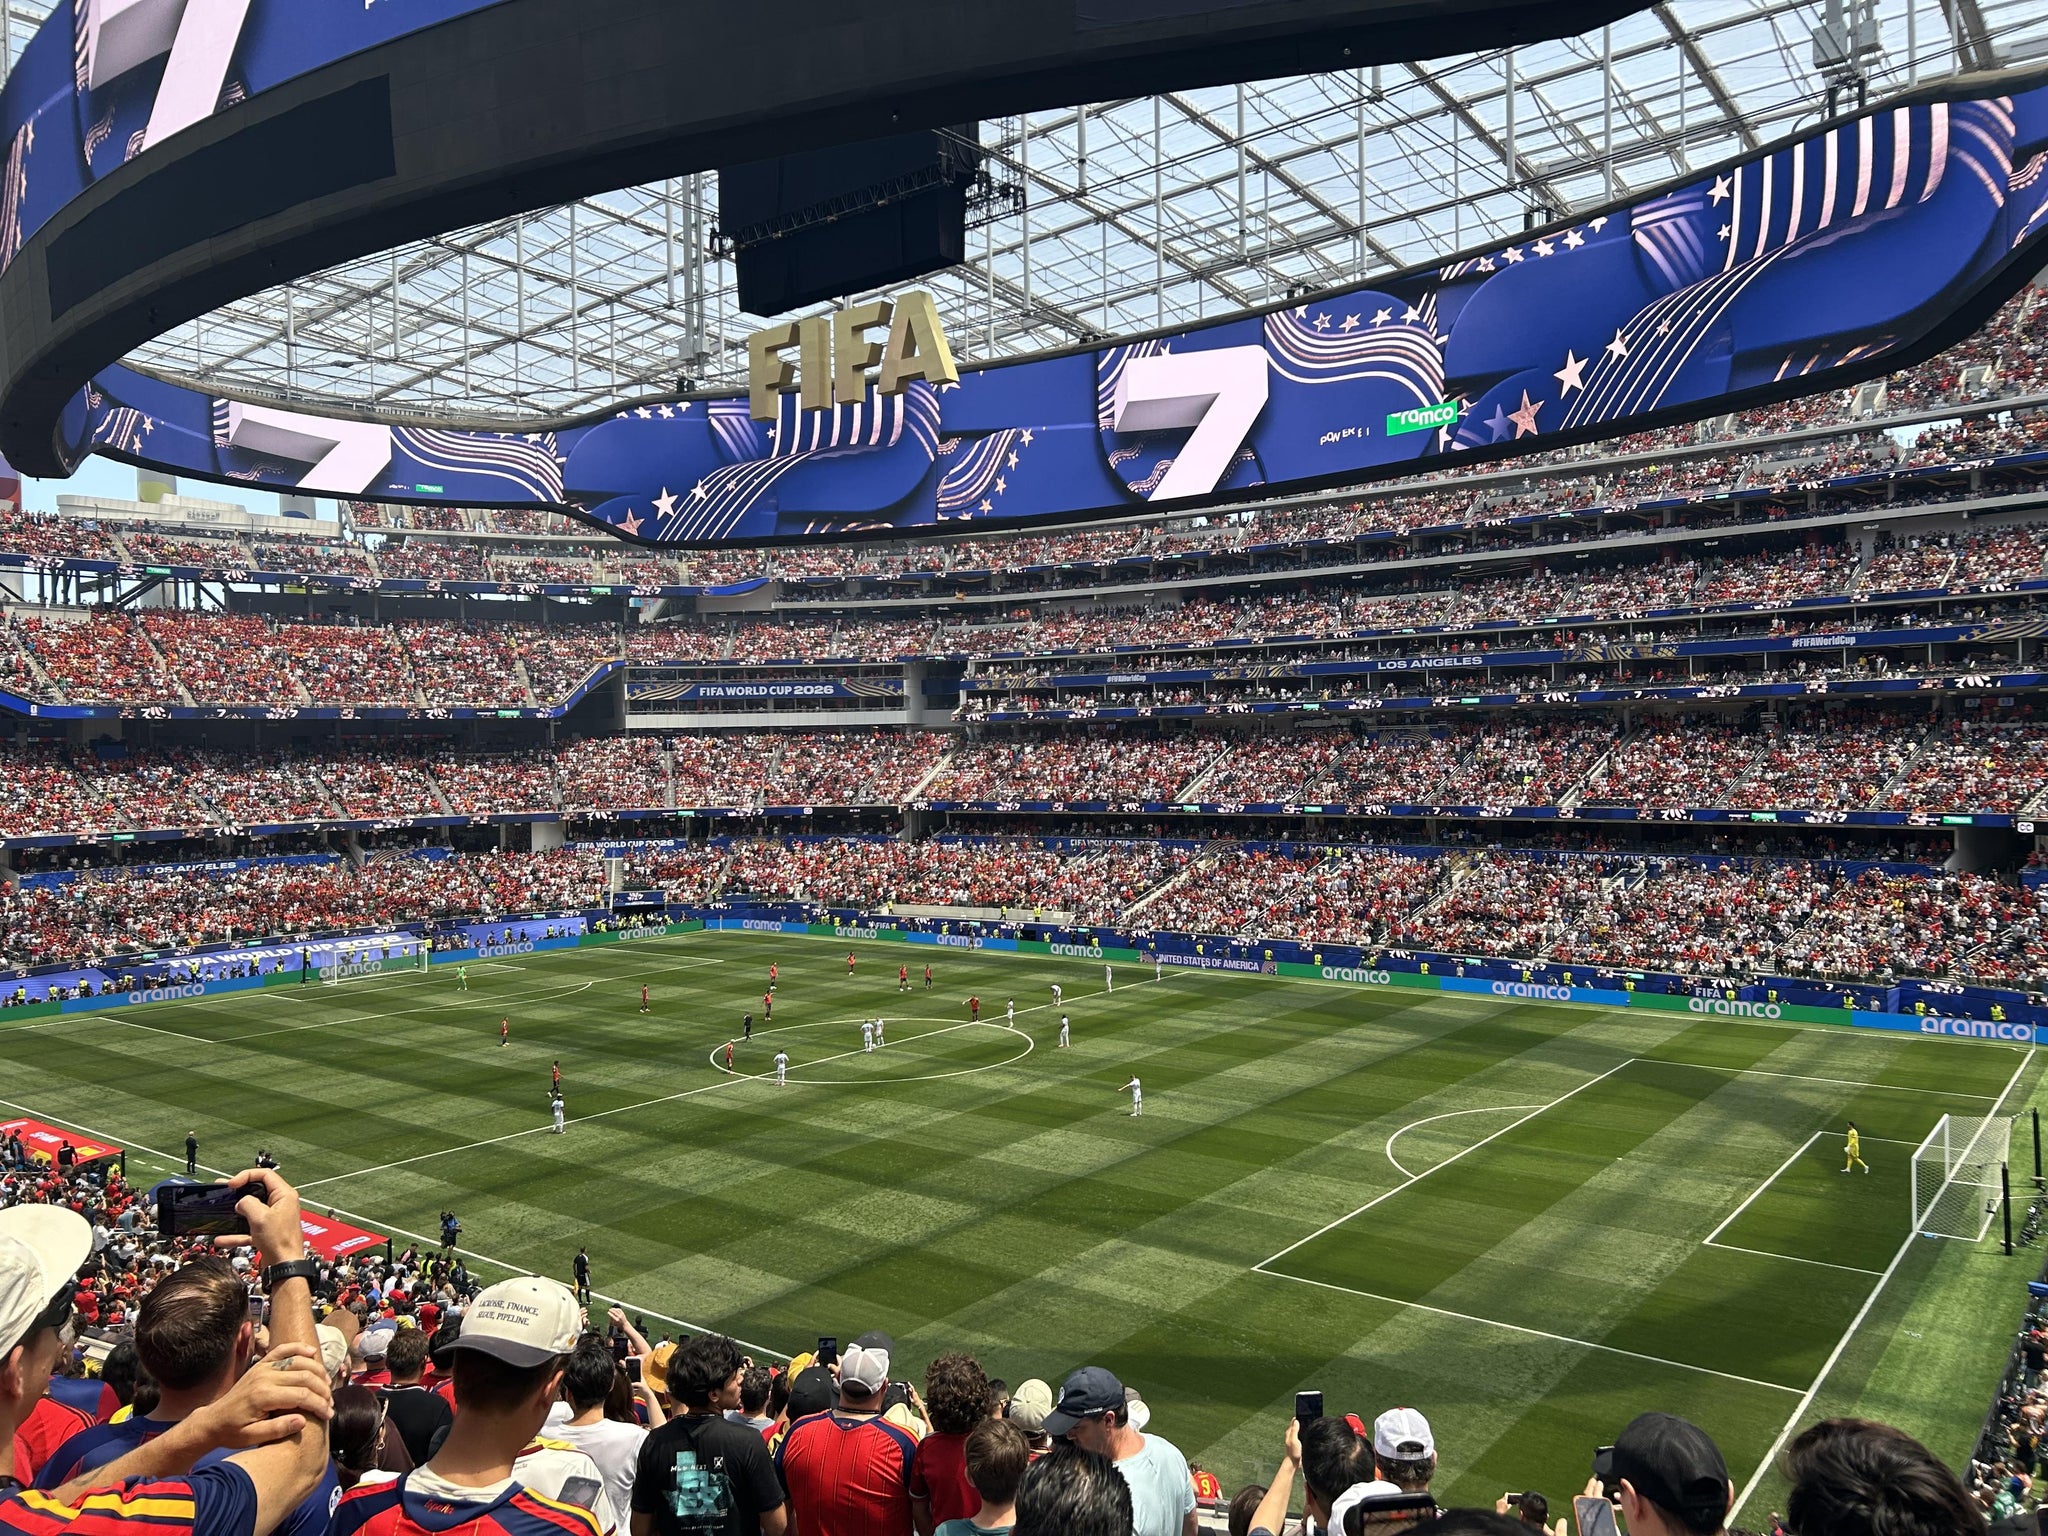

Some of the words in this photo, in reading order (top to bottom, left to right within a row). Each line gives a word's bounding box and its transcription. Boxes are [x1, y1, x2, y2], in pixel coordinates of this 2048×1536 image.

[749, 290, 960, 422] FIFA
[1114, 344, 1270, 502] 7
[1792, 635, 1856, 648] #FIFAWorldCup
[1377, 659, 1407, 670] LOS
[1409, 656, 1483, 669] ANGELES
[700, 687, 724, 697] FIFA
[726, 686, 767, 697] WORLD
[769, 686, 792, 696] CUP
[794, 685, 834, 695] 2026
[595, 841, 627, 849] WORLD
[627, 840, 645, 848] CUP
[618, 925, 667, 940] aramco
[743, 919, 782, 931] aramco
[835, 926, 877, 939] aramco
[168, 955, 218, 968] FIFA
[216, 947, 300, 963] WORLD
[299, 942, 334, 954] CUP
[334, 935, 403, 949] 2026
[478, 940, 534, 958] aramco
[1050, 943, 1103, 958] aramco
[318, 960, 382, 978] aramco
[1182, 955, 1212, 967] STATES
[1212, 958, 1222, 968] OF
[1222, 959, 1260, 971] AMERICA
[1321, 966, 1391, 985] aramco
[128, 983, 205, 1005] aramco
[1491, 980, 1572, 1000] aramco
[1695, 987, 1721, 998] FIFA
[1688, 997, 1781, 1019] aramco
[1921, 1016, 2032, 1041] aramco
[506, 1302, 539, 1317] FINANCE,
[1201, 1479, 1211, 1495] 9
